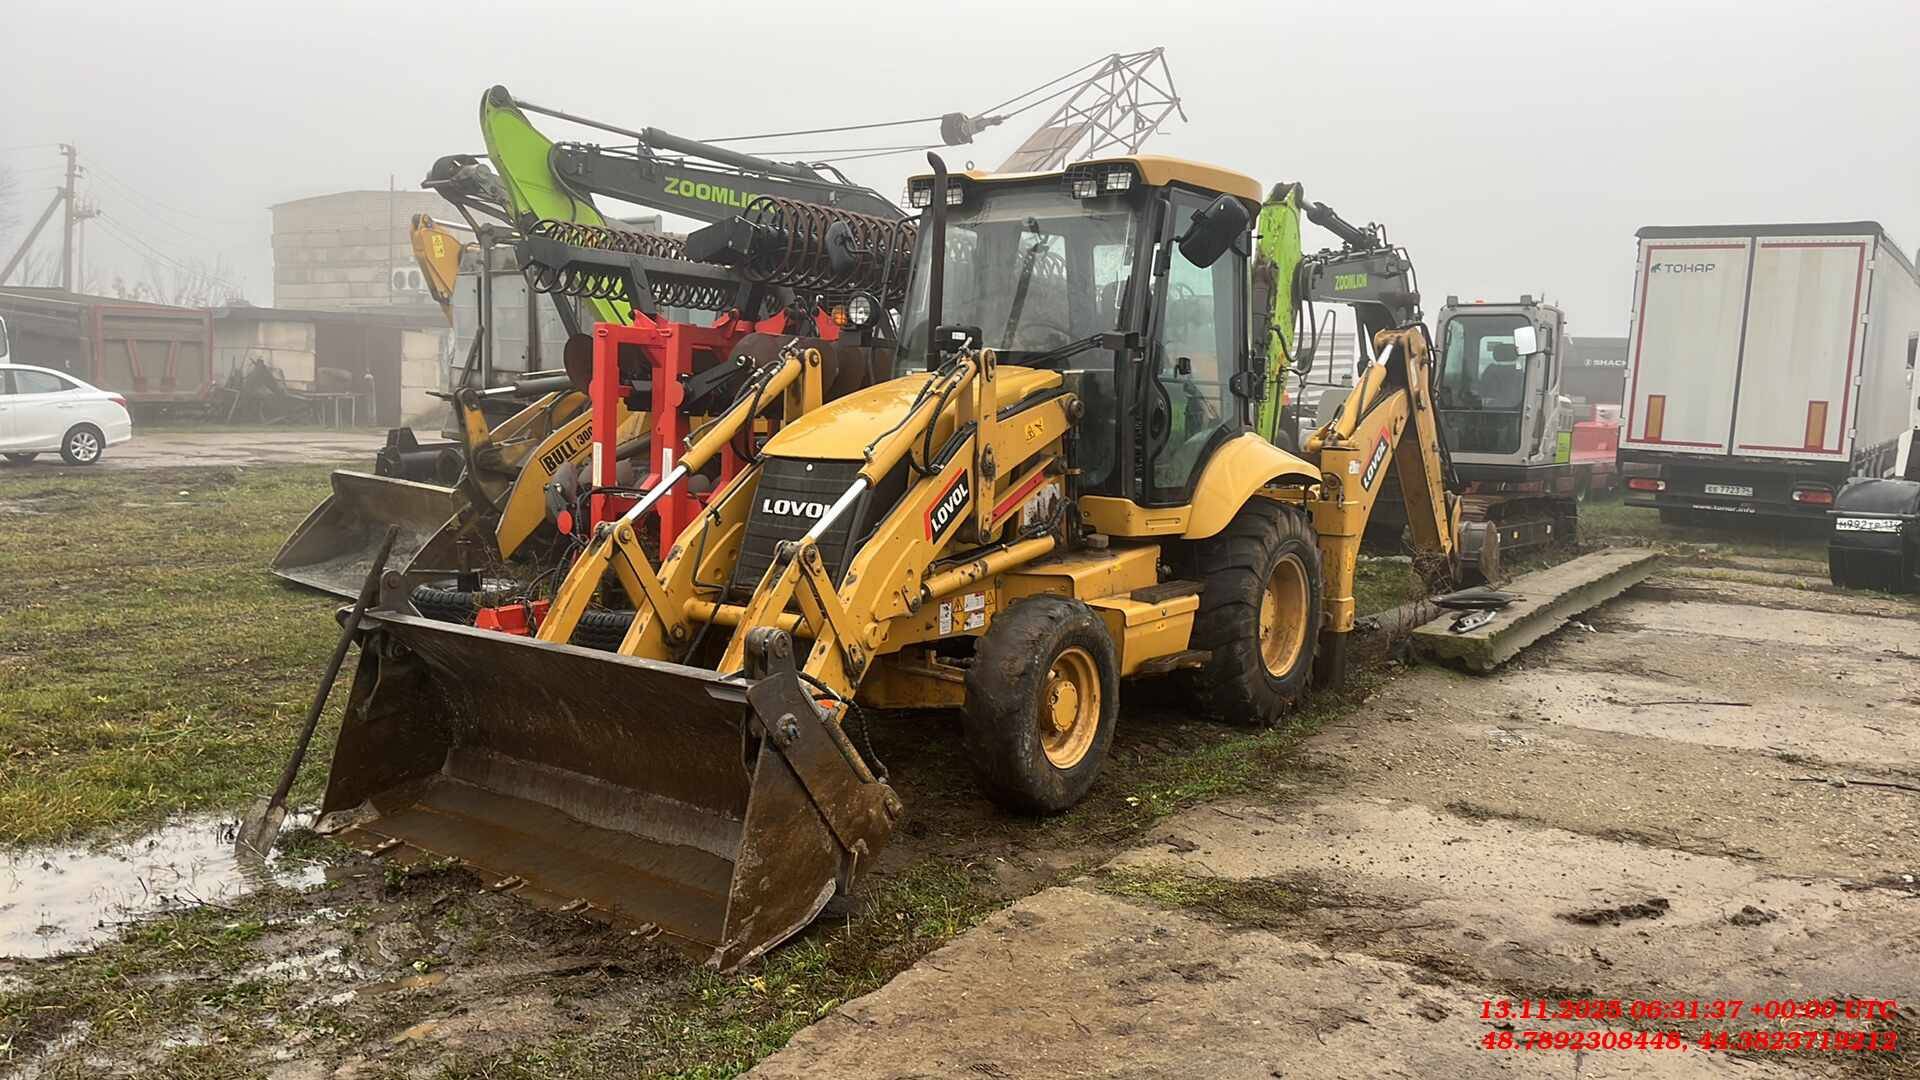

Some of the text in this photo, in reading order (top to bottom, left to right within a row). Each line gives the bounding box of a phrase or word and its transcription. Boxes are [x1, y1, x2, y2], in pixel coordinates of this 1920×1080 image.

[1664, 263, 1715, 273] ТОНАР
[543, 441, 577, 472] BULL
[1363, 441, 1386, 489] LOVOL
[931, 482, 969, 533] LOVOL
